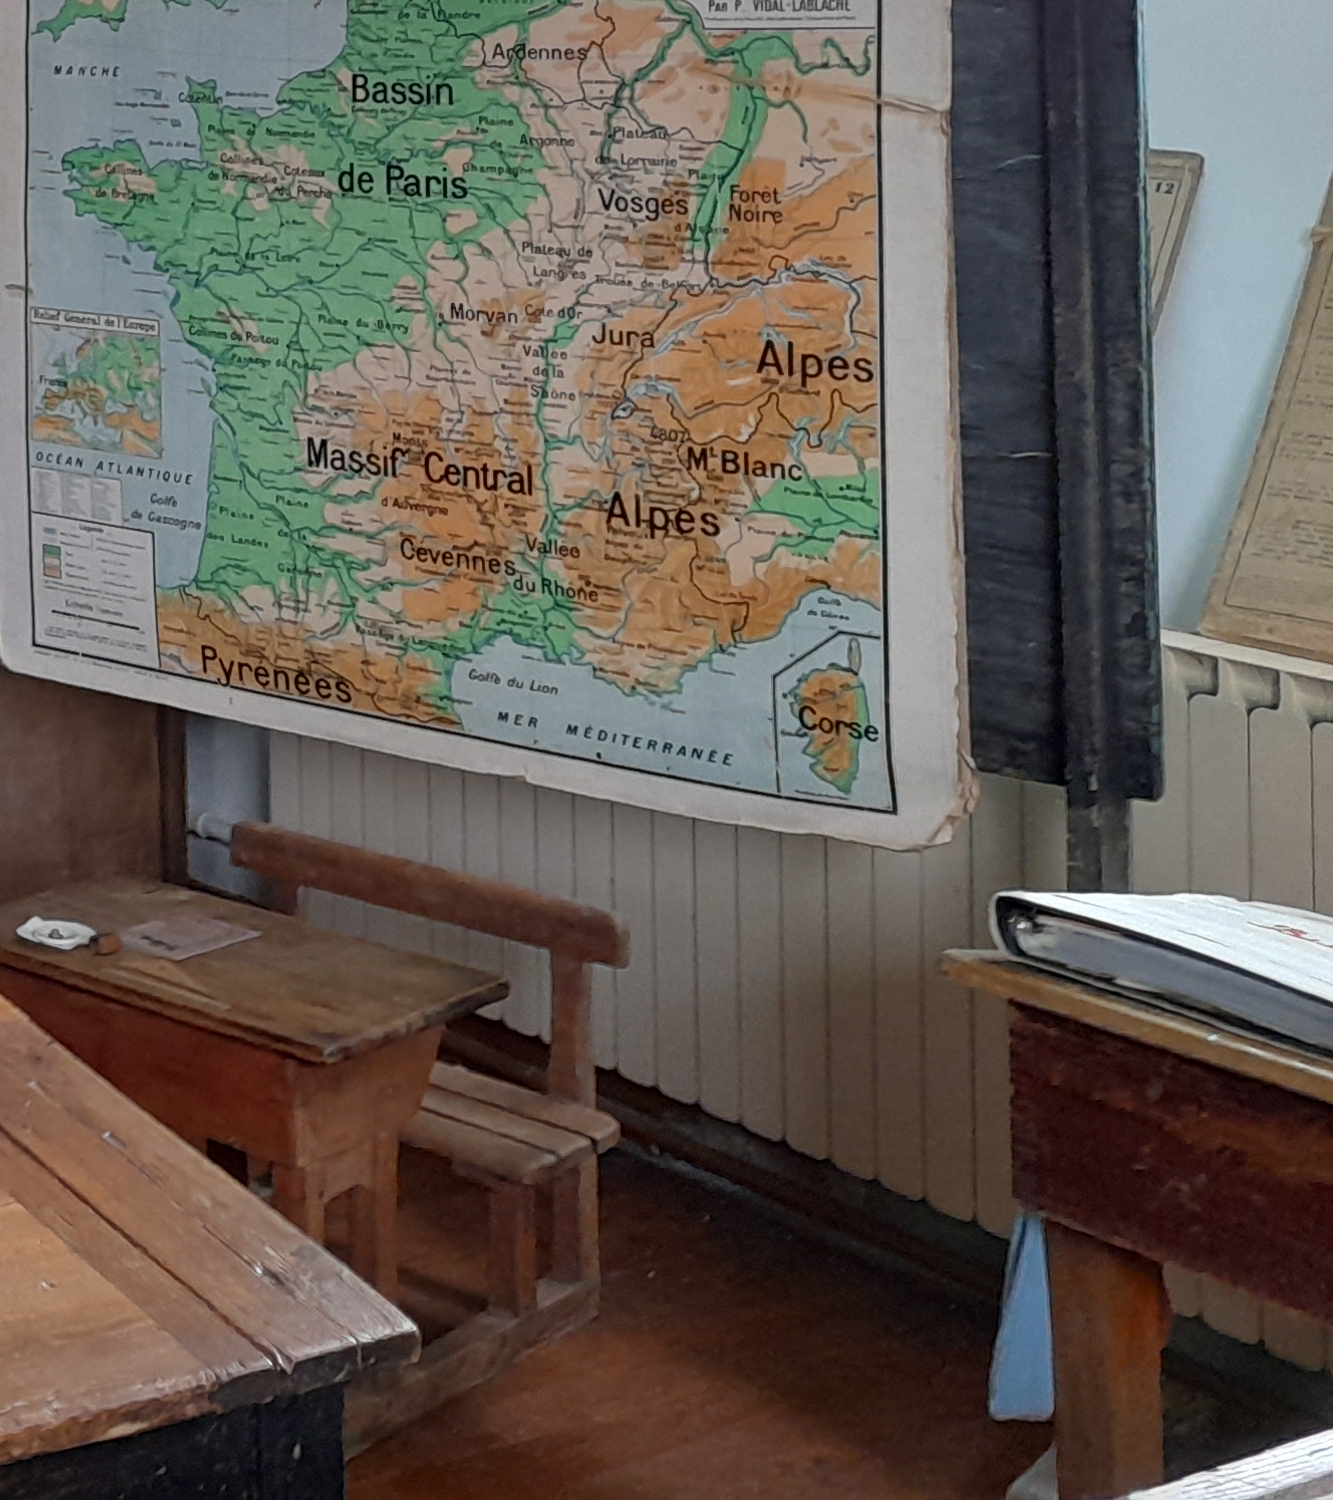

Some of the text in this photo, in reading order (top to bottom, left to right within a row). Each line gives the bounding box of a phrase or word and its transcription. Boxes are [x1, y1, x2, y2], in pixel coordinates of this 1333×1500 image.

[491, 43, 587, 61] Ardennes
[53, 65, 121, 78] MANCHE
[351, 73, 454, 106] Bassin
[612, 126, 670, 140] Plateau
[620, 156, 679, 168] Lorraine
[337, 162, 468, 200] de Paris
[1154, 181, 1176, 195] 12
[597, 188, 689, 222] Vosges
[729, 202, 783, 224] Noire
[450, 302, 519, 325] Morvan
[591, 321, 655, 349] Jura
[756, 339, 874, 388] Alpes
[35, 450, 193, 486] OCÉAN ATLANTIQUE
[306, 436, 533, 497] Massif Central
[687, 445, 803, 482] Mt Blanc
[606, 490, 722, 540] Alpes
[399, 537, 517, 578] Cévennes
[513, 570, 598, 603] du Rhône
[467, 667, 559, 696] Golfe du Lion
[497, 711, 734, 767] MER MÉDITERRANÉE
[797, 705, 880, 742] Corse
